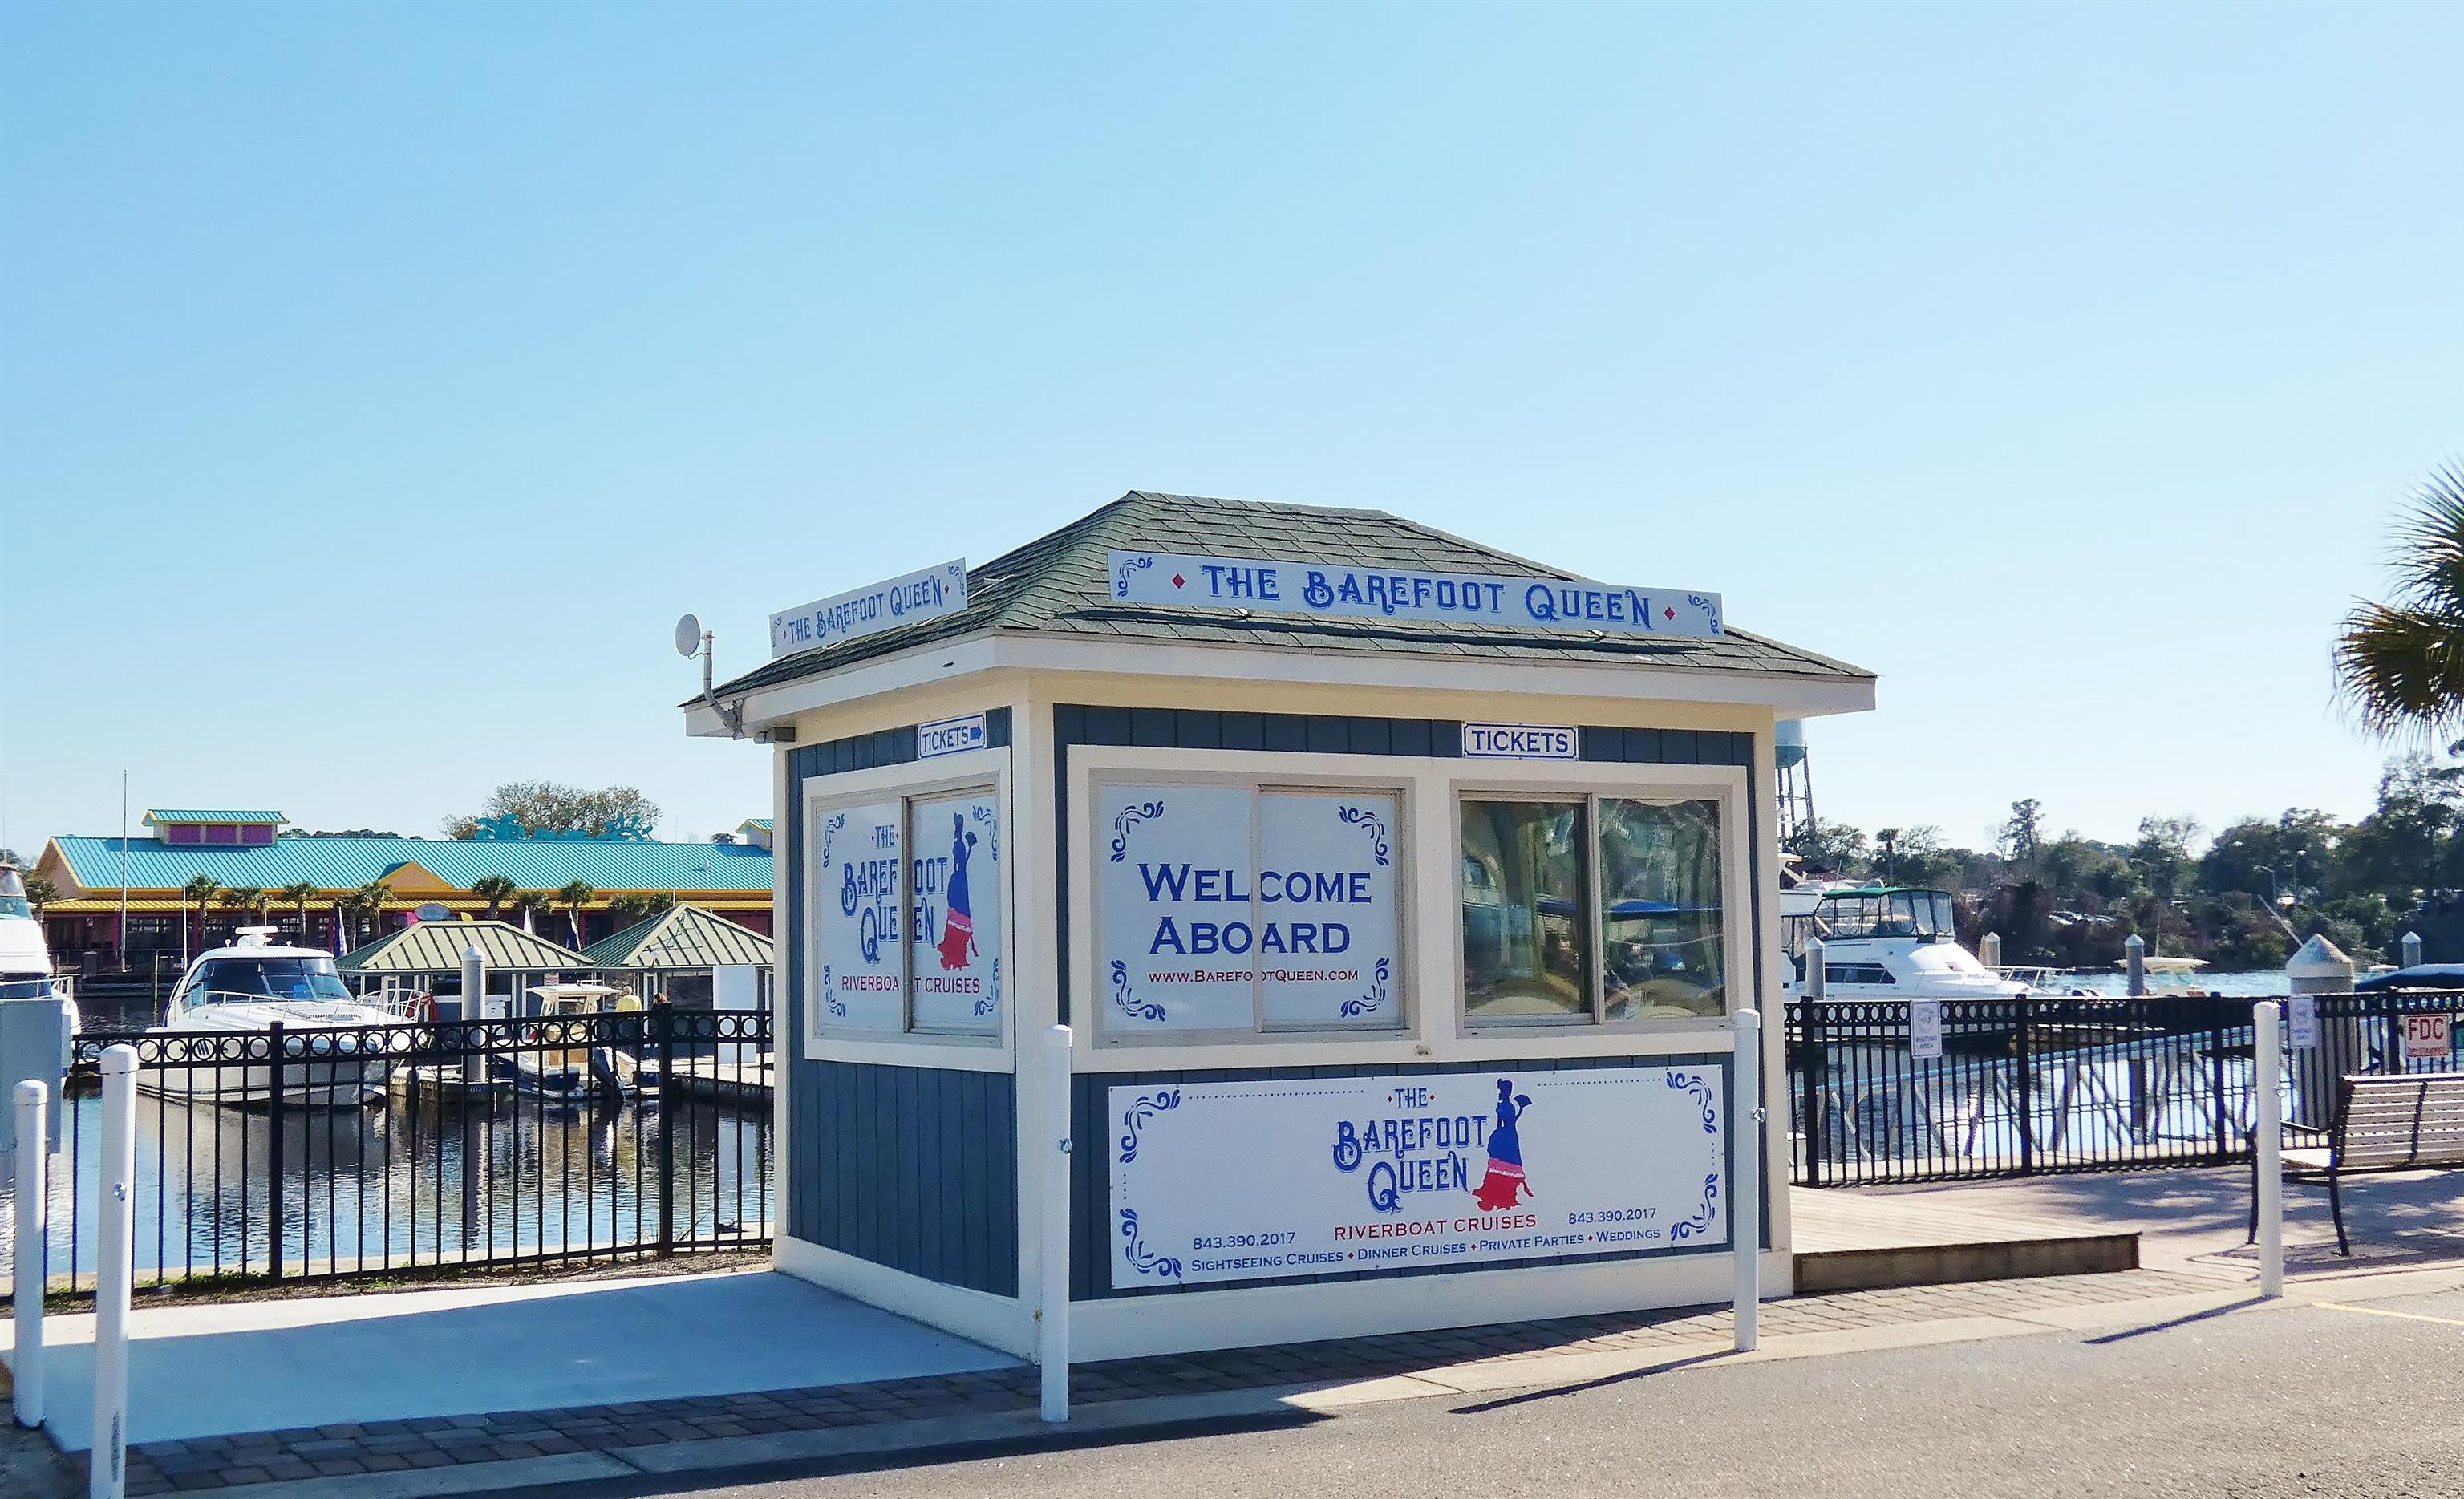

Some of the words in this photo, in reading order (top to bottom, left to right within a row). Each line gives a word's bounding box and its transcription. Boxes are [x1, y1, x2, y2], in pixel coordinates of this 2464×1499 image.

[788, 614, 811, 644] THE
[816, 592, 884, 639] BAREFOOT
[890, 575, 943, 617] QUEEN
[1202, 565, 1281, 601] THE
[1303, 570, 1506, 615] BAREFOOT
[1524, 583, 1654, 630] QUEEN
[922, 725, 969, 752] TICKETS
[1471, 730, 1569, 753] TICKETS
[875, 824, 895, 849] THE
[841, 857, 948, 918] BAREFOOT
[1137, 863, 1372, 904] WELCOME
[861, 897, 936, 966] QUEEN
[1148, 915, 1352, 955] ABOARD
[841, 975, 922, 994] RIVERBOAT
[925, 976, 980, 994] CRUISES
[2409, 1018, 2444, 1041] FDC
[1393, 1088, 1429, 1108] THE
[1333, 1115, 1488, 1173] BAREFOOT
[1368, 1151, 1471, 1214] QUEEN
[1334, 1219, 1448, 1241] RIVERBOAT
[1453, 1214, 1537, 1233] CRUISES
[1569, 1208, 1657, 1225] 843.390.2017
[1191, 1254, 1283, 1272] SIGHTSEEING
[1286, 1251, 1344, 1266] CRUISES
[1357, 1247, 1408, 1262] DINNER
[1411, 1243, 1467, 1257] CRUISES
[1479, 1238, 1531, 1252] PRIVATE
[1534, 1234, 1585, 1246] PARTIES
[1596, 1228, 1661, 1244] WEDDINGS
[1193, 1232, 1296, 1250] 843.390.2017
